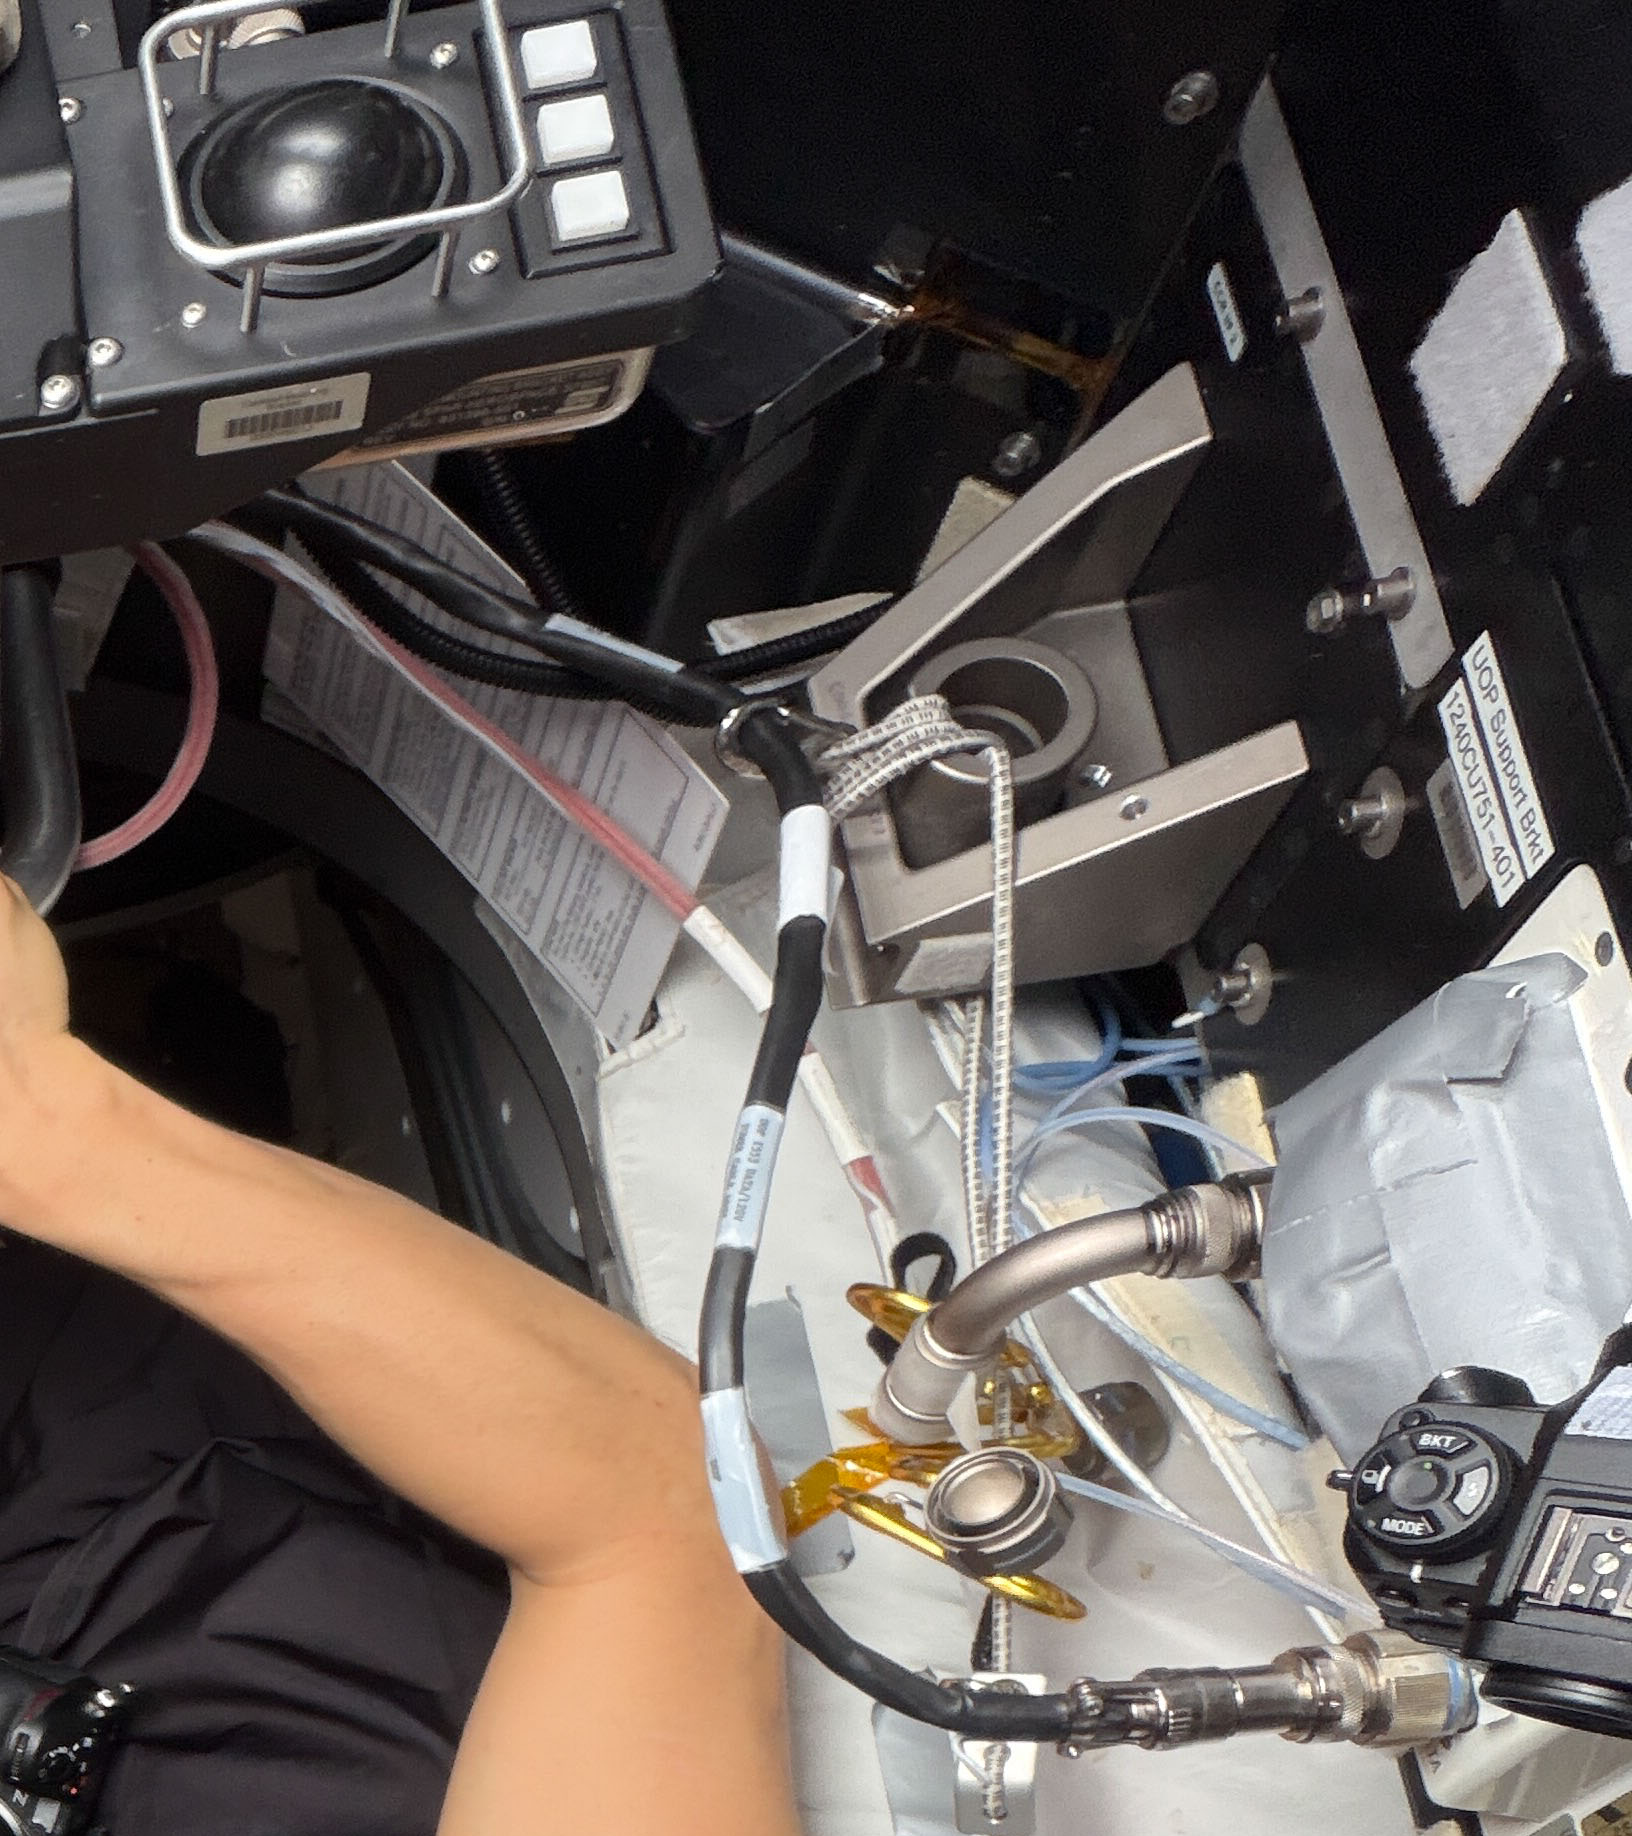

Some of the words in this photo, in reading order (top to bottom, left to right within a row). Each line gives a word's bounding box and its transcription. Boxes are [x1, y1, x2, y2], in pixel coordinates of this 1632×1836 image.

[1444, 691, 1517, 890] 1240CU751-401
[1471, 643, 1501, 705] UOP
[1489, 707, 1529, 810] Support
[1518, 806, 1545, 866] Brkt
[1418, 1433, 1457, 1449] BKT
[1381, 1517, 1426, 1536] MODE
